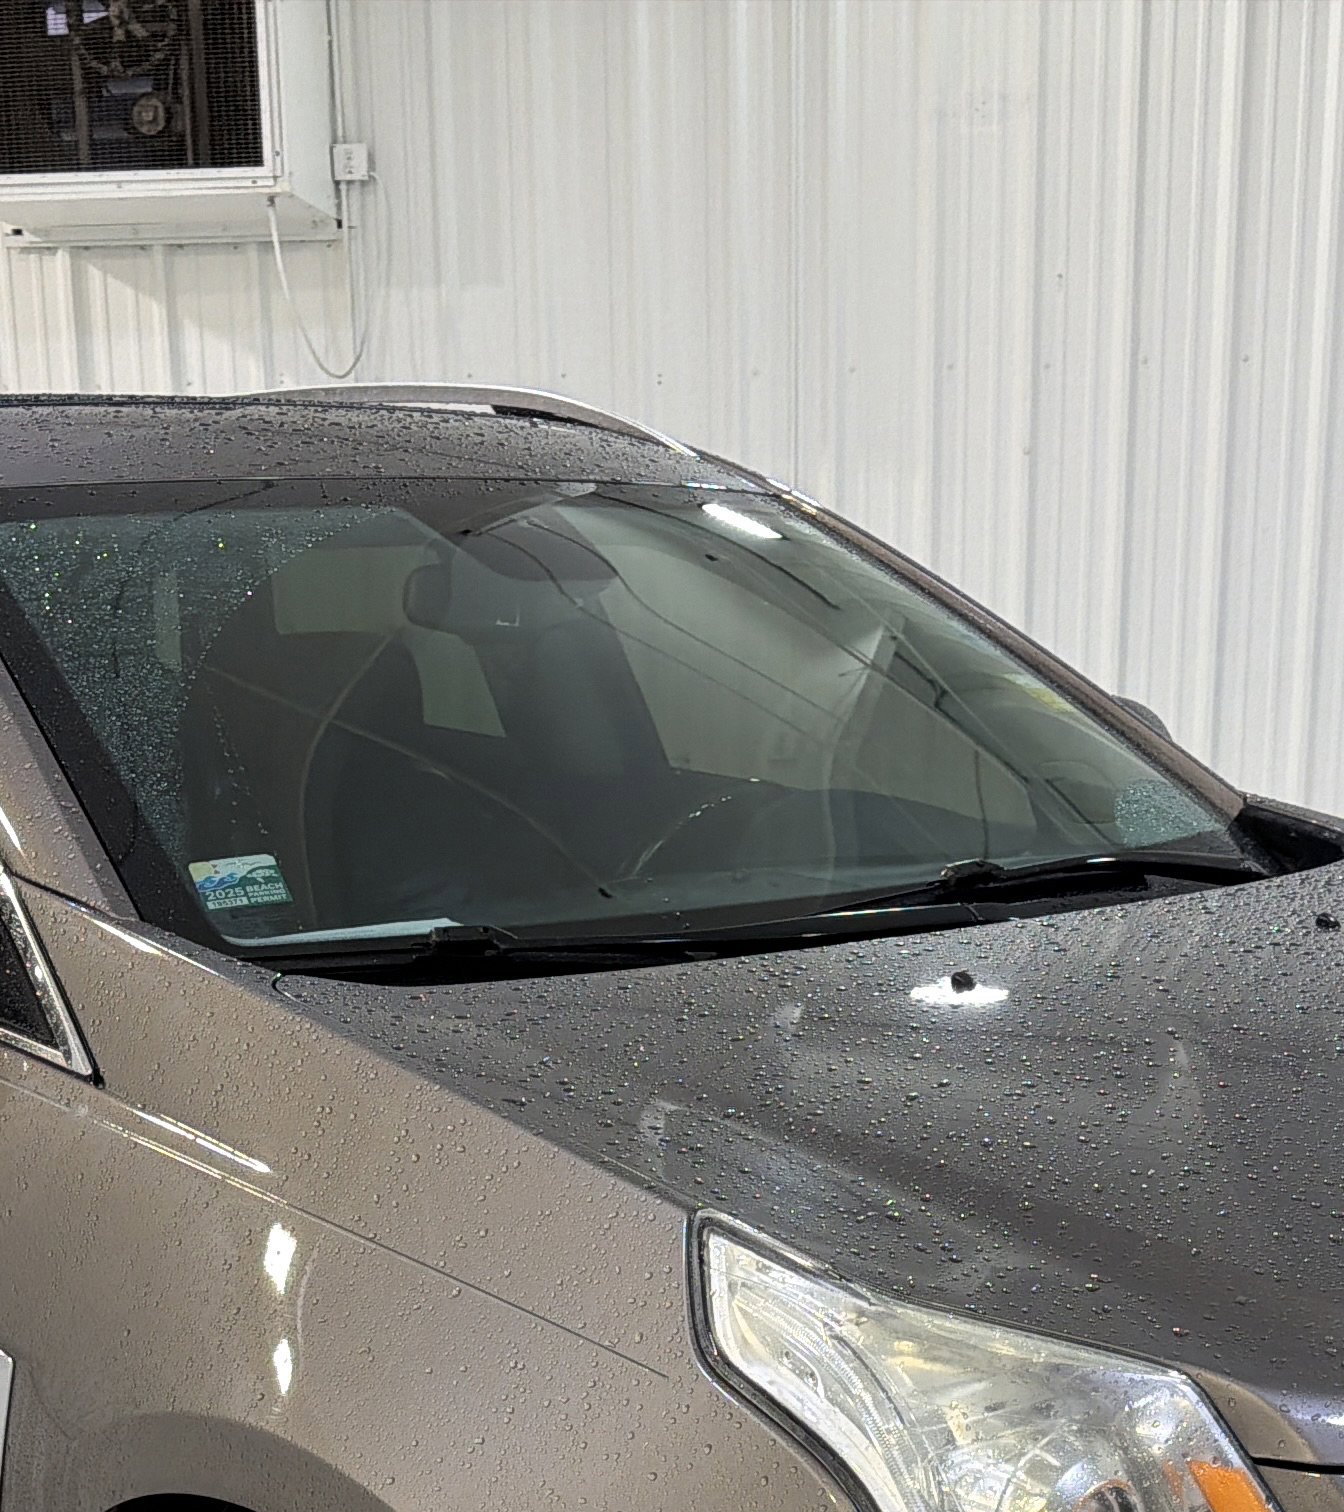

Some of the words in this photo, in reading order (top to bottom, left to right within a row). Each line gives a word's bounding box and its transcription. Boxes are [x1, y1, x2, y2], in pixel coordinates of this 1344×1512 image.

[246, 882, 283, 892] BEACH
[205, 887, 244, 901] 2025
[248, 888, 286, 897] PARKING
[250, 894, 287, 903] PERMIT
